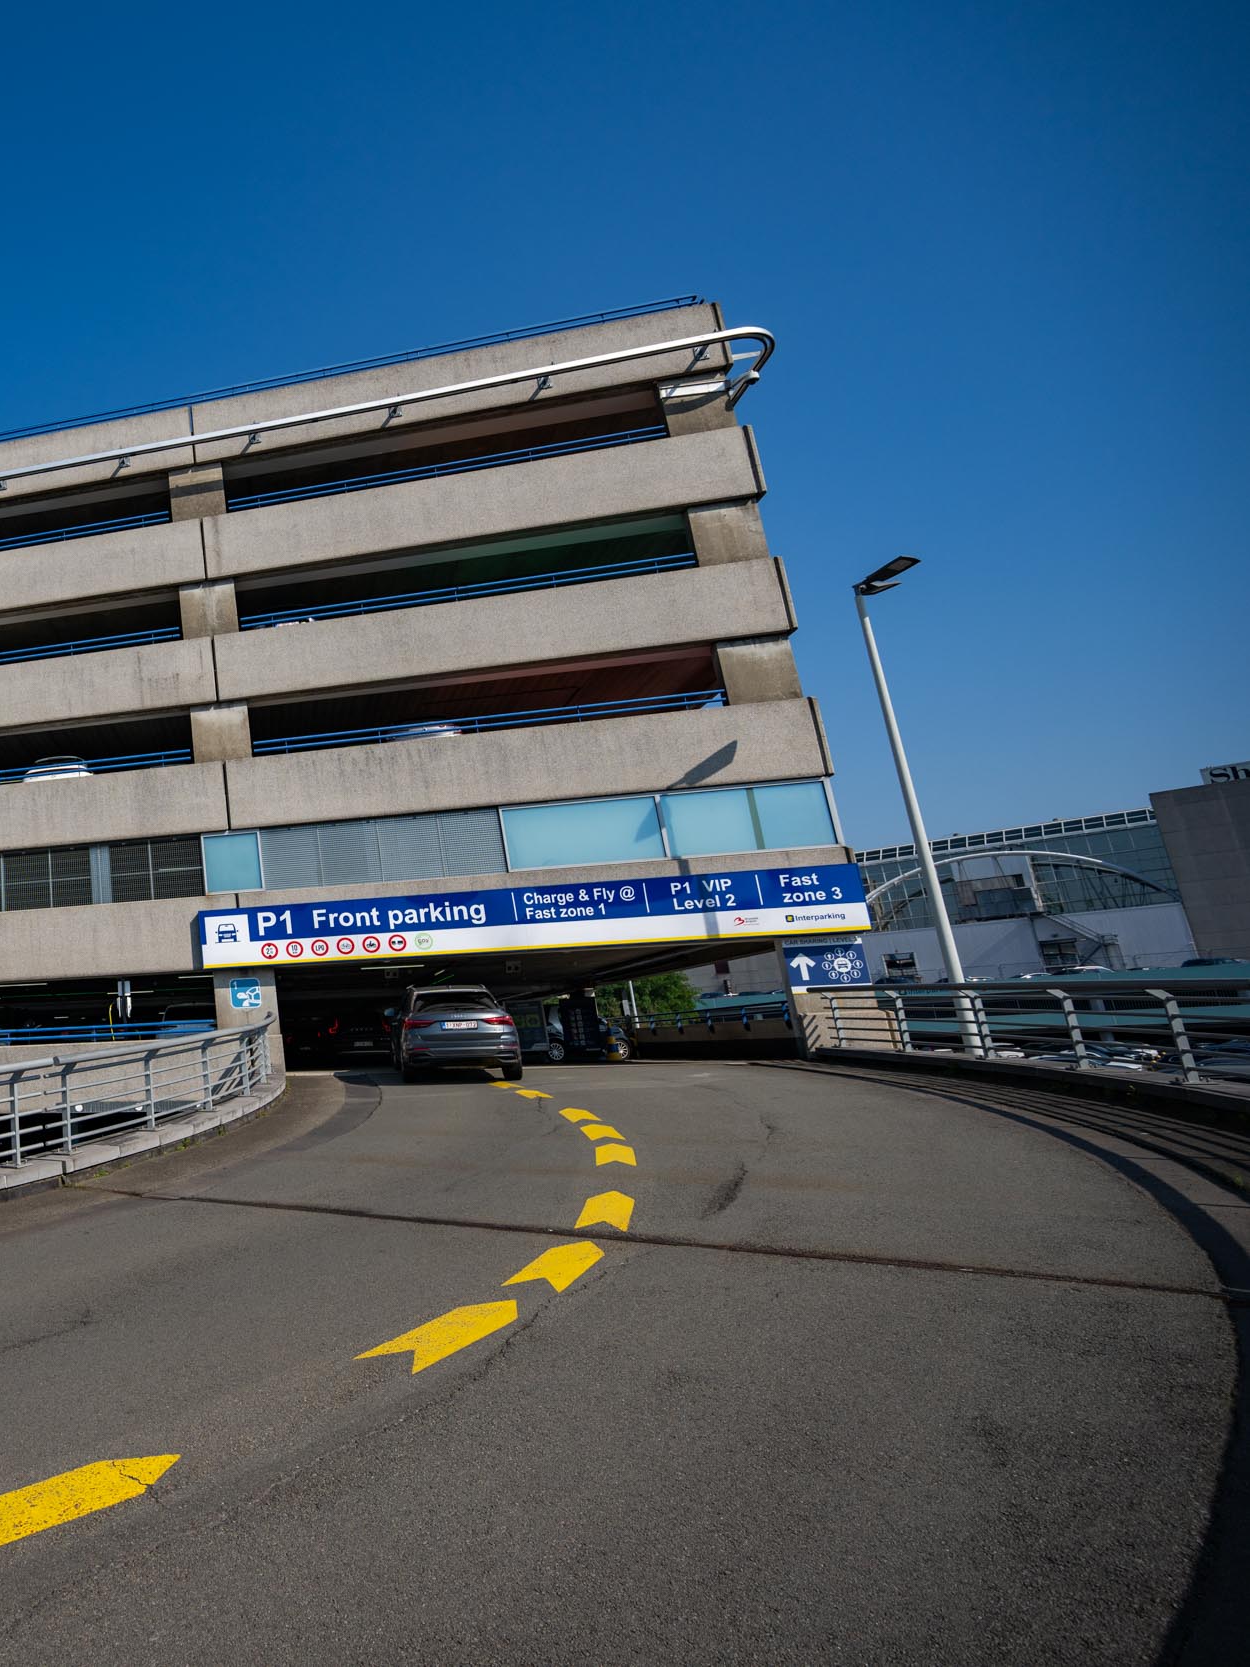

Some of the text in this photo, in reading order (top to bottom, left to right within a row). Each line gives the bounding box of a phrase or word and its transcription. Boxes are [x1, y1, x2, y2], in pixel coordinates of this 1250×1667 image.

[670, 878, 732, 895] P1 VIP
[779, 873, 819, 887] Fast
[523, 886, 636, 905] Charge & Fly @
[673, 894, 736, 910] Level 2
[782, 887, 843, 903] zone 3
[256, 901, 487, 936] P1 Front parking
[525, 903, 606, 920] Fast zone 1
[795, 912, 846, 922] Interparking
[232, 981, 238, 990] 1
